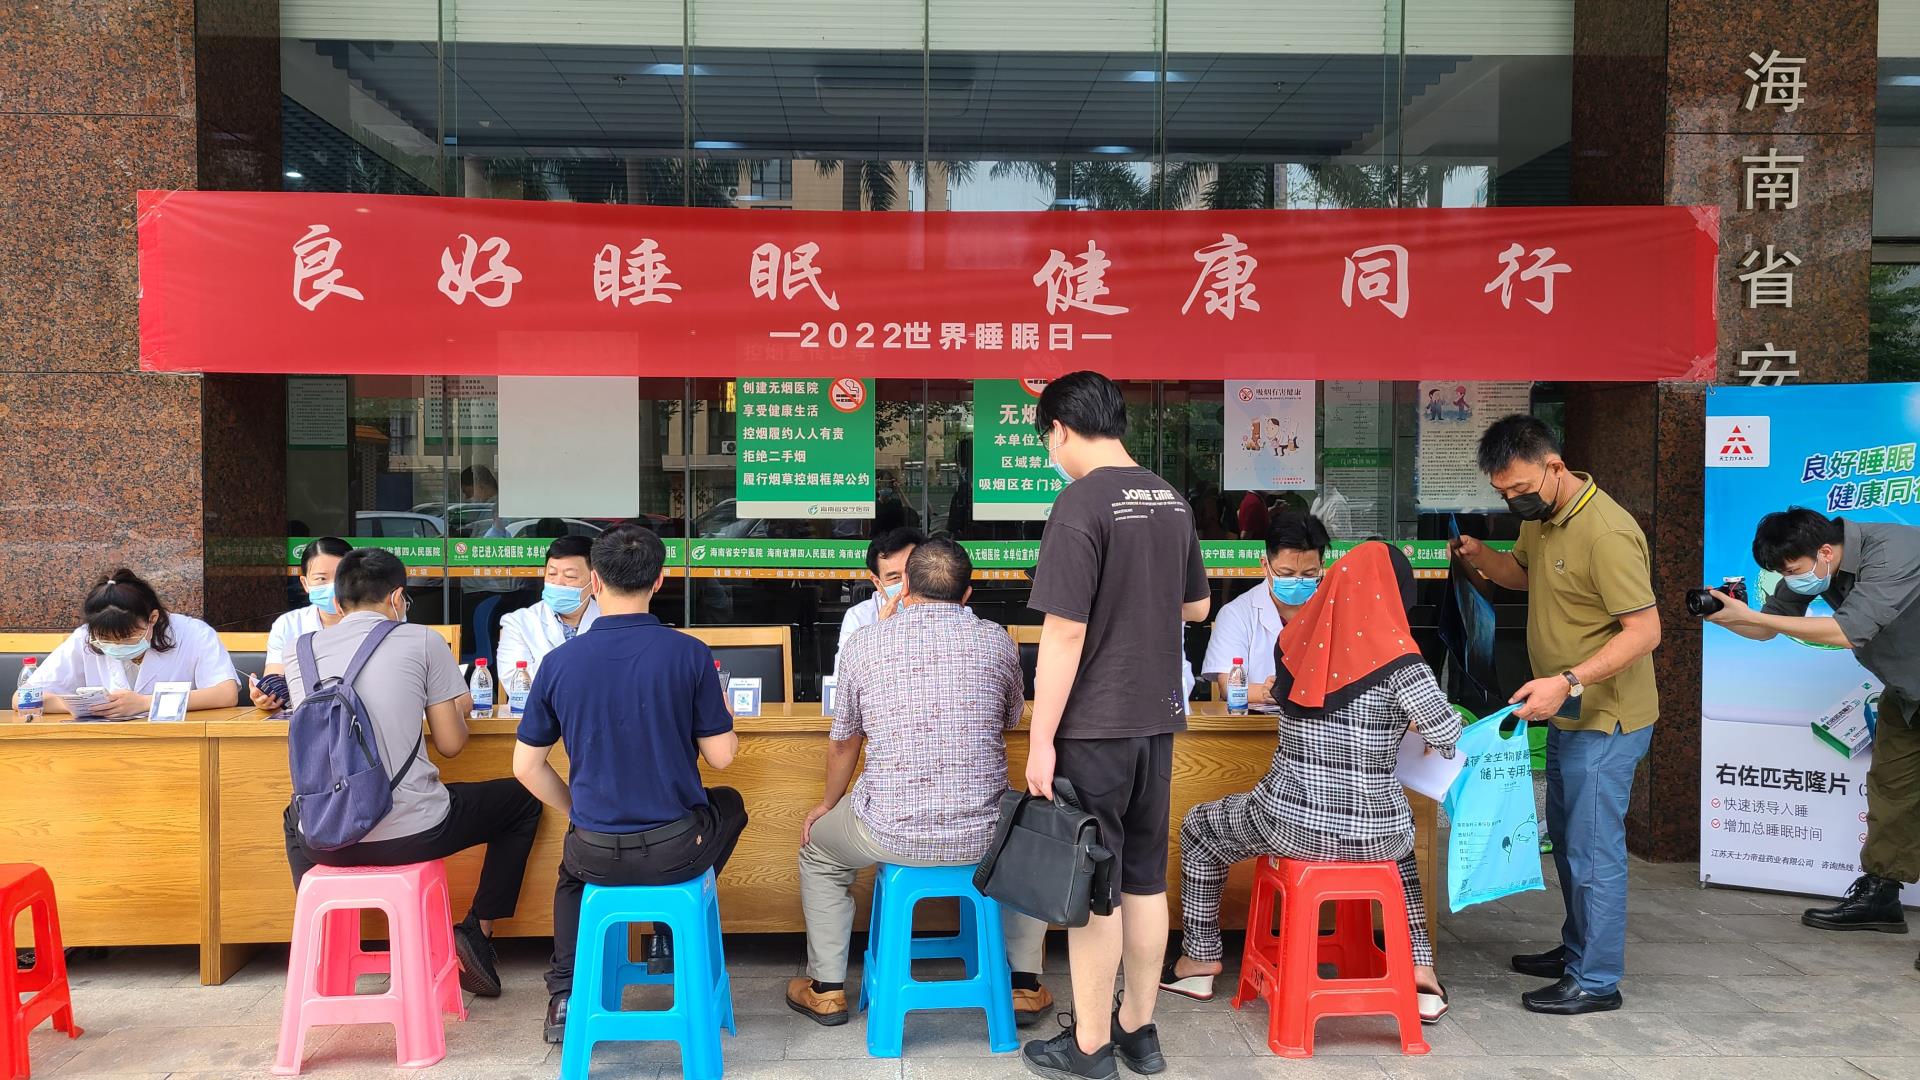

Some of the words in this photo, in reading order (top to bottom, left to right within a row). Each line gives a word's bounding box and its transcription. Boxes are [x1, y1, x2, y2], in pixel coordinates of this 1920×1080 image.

[292, 224, 840, 311] 良好睡眠
[1033, 233, 1572, 320] 健康同行
[742, 381, 819, 395] 创建无烟医院
[1255, 387, 1302, 397] 吸烟有害健康
[742, 403, 819, 418] 享受健康生活
[742, 427, 845, 441] 控烟履约人人有责
[742, 449, 807, 464] 拒绝二手烟
[1801, 443, 1917, 484] 良好睡眠
[742, 471, 870, 487] 履行烟草控烟框架公约
[978, 477, 1074, 492] 吸烟区在门诊
[709, 546, 763, 558] 海南省安宁医院
[766, 547, 836, 559] 海南省第四人民医院
[1715, 763, 1851, 796] 右佐匹克隆片
[1723, 796, 1809, 818] 快速诱导入睡
[1723, 818, 1823, 842] 增加总睡眠时间
[1710, 848, 1814, 868] 江苏天士力帝益药业有限公司
[1821, 860, 1855, 873] 咨询热线
